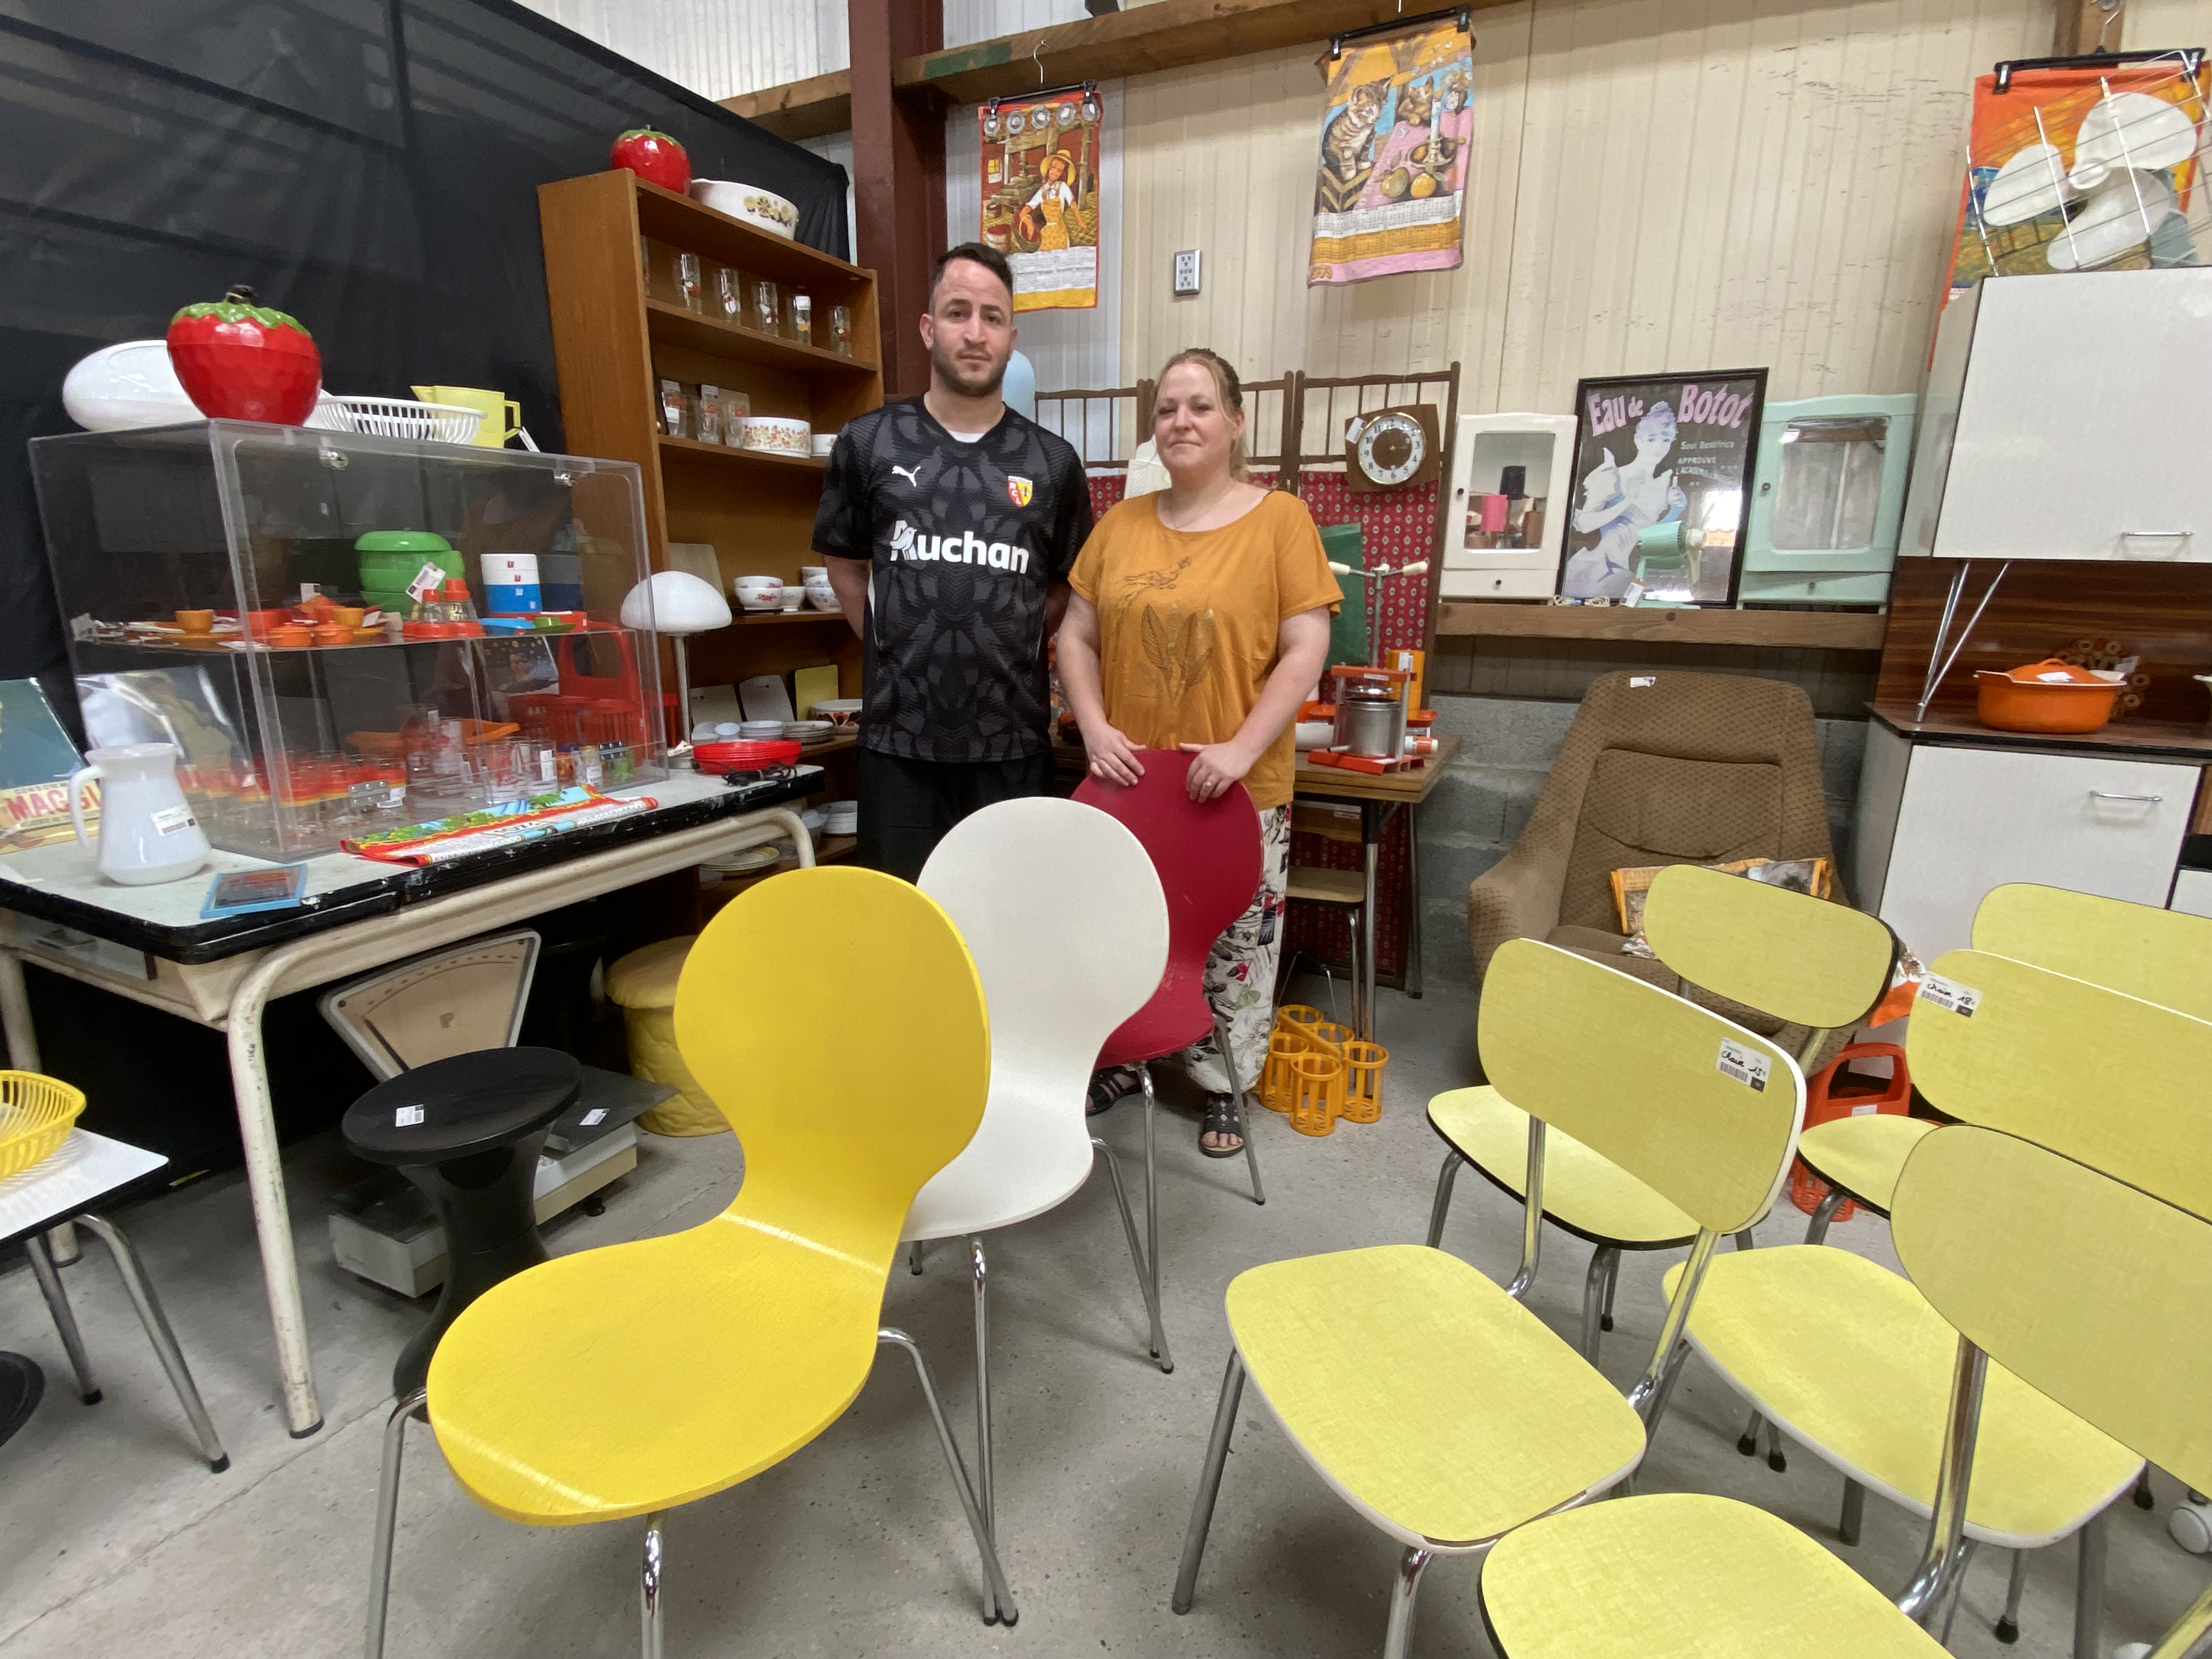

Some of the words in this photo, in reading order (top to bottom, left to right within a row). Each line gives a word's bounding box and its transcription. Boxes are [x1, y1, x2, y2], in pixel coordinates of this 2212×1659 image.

[1588, 393, 1627, 437] Eau
[1628, 396, 1644, 418] de
[1677, 383, 1753, 429] Botot
[889, 520, 1030, 574] Auchan
